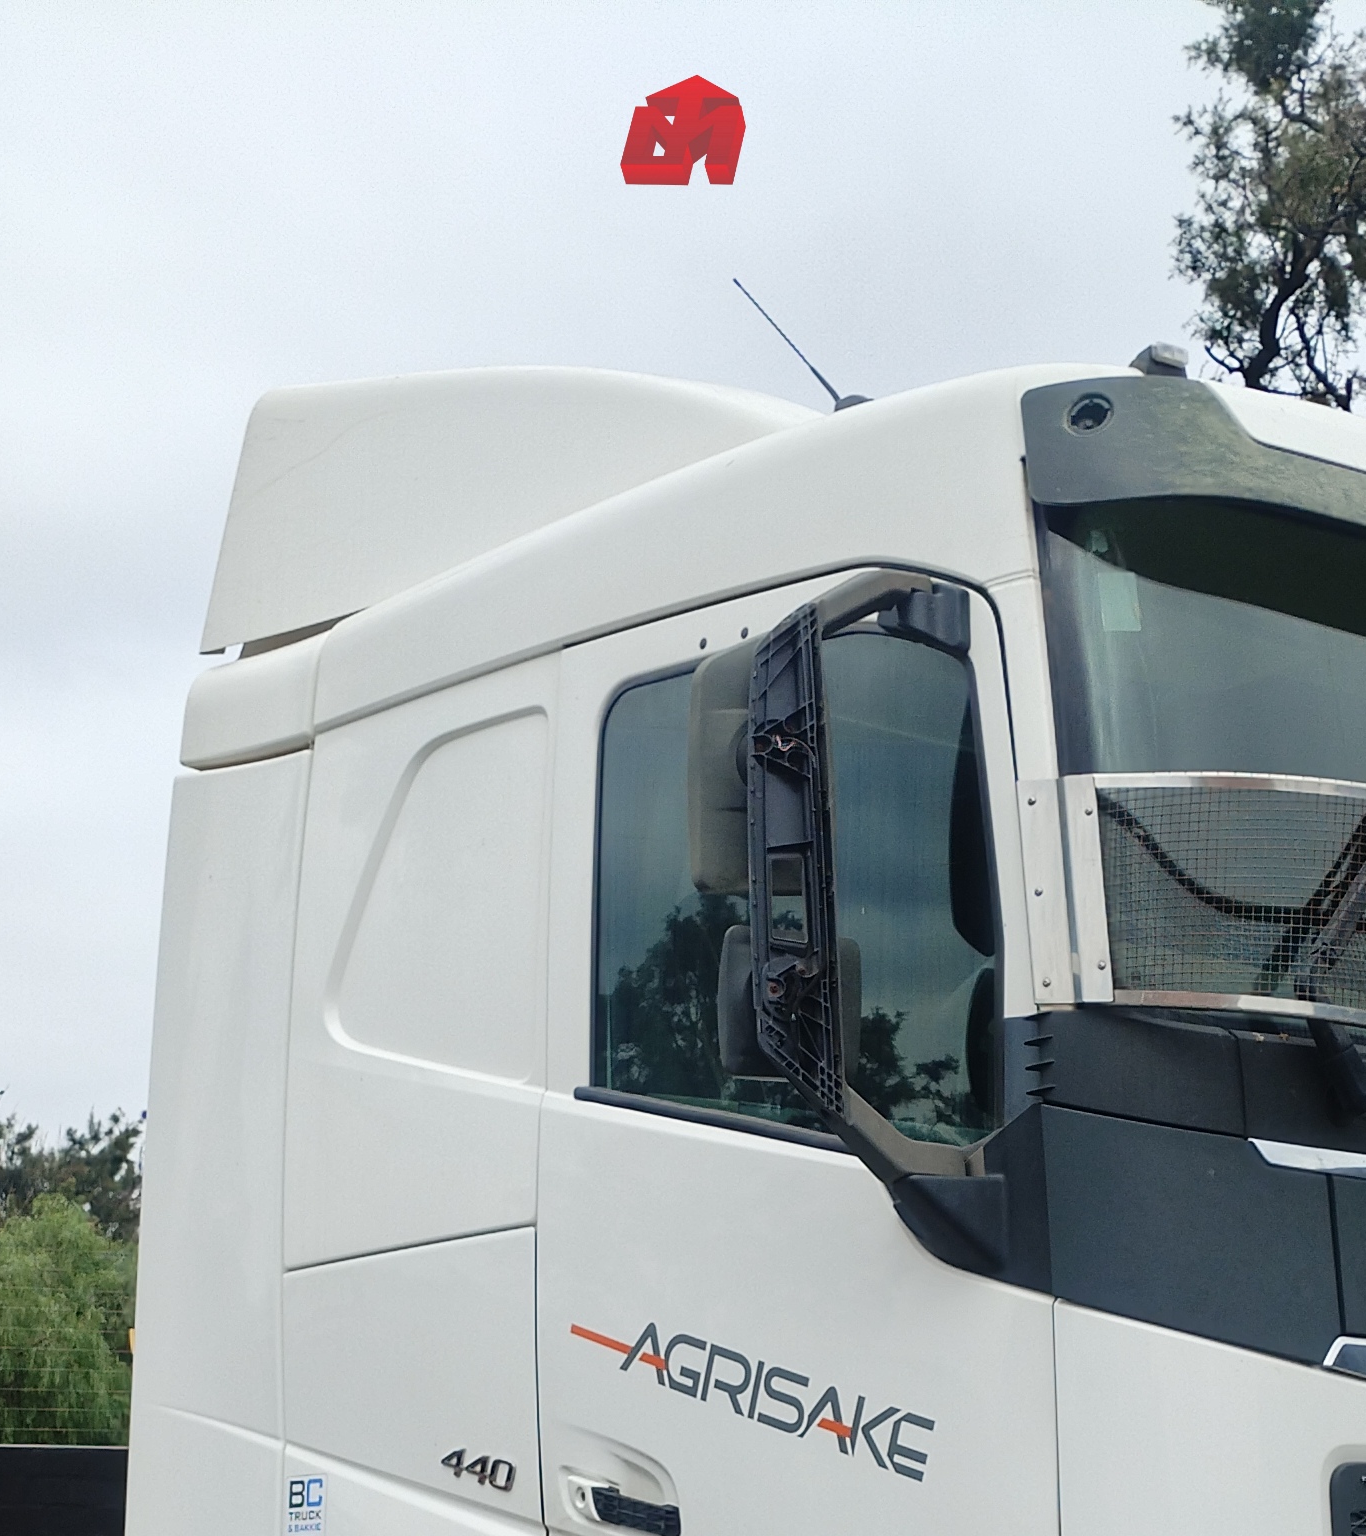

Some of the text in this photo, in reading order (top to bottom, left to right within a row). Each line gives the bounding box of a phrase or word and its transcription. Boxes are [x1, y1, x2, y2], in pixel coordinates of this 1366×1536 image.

[619, 1322, 935, 1483] AGRISAKE
[441, 1448, 516, 1492] 440
[288, 1478, 323, 1508] BC
[288, 1510, 322, 1521] TRUCK
